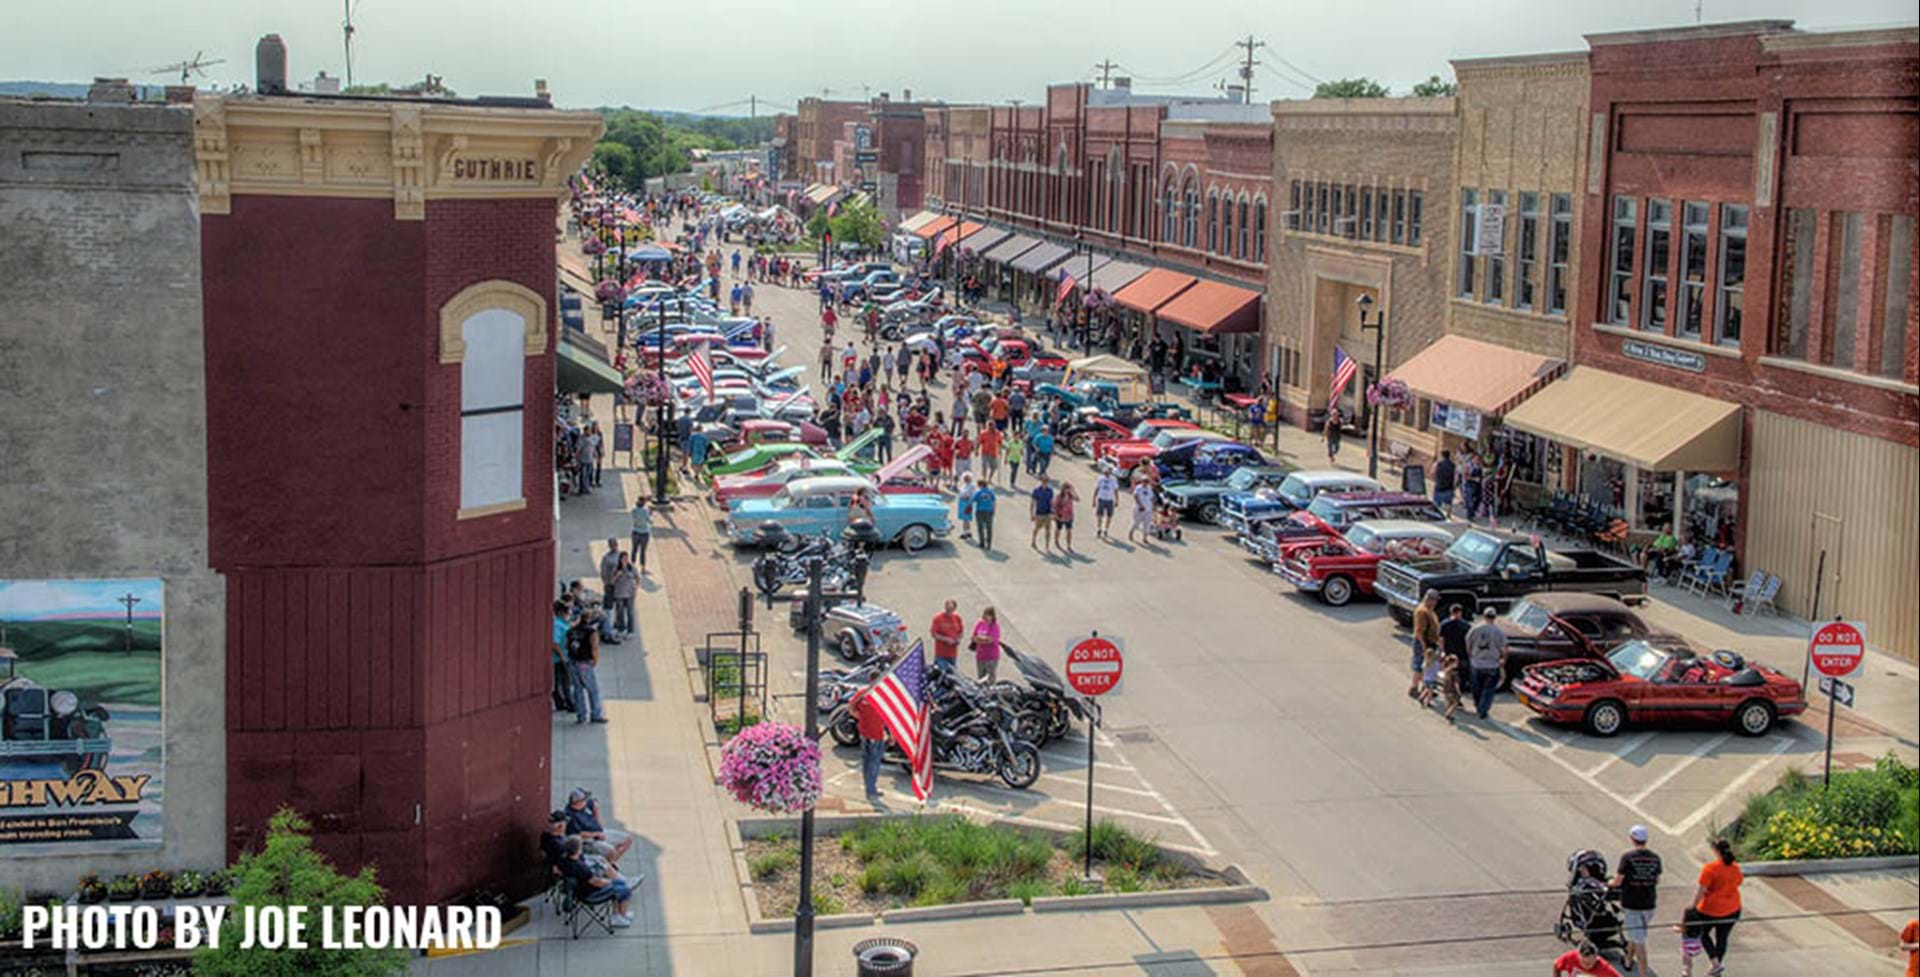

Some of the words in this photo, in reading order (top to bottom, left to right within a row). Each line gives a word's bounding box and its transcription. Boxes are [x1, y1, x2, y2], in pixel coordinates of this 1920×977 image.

[454, 158, 535, 180] GUTHRIE
[1819, 632, 1833, 642] DO
[1837, 632, 1856, 643] NOT
[1074, 649, 1089, 660] DO
[1092, 648, 1115, 660] NOT
[1821, 656, 1851, 667] ENTER
[1077, 675, 1110, 686] ENTER
